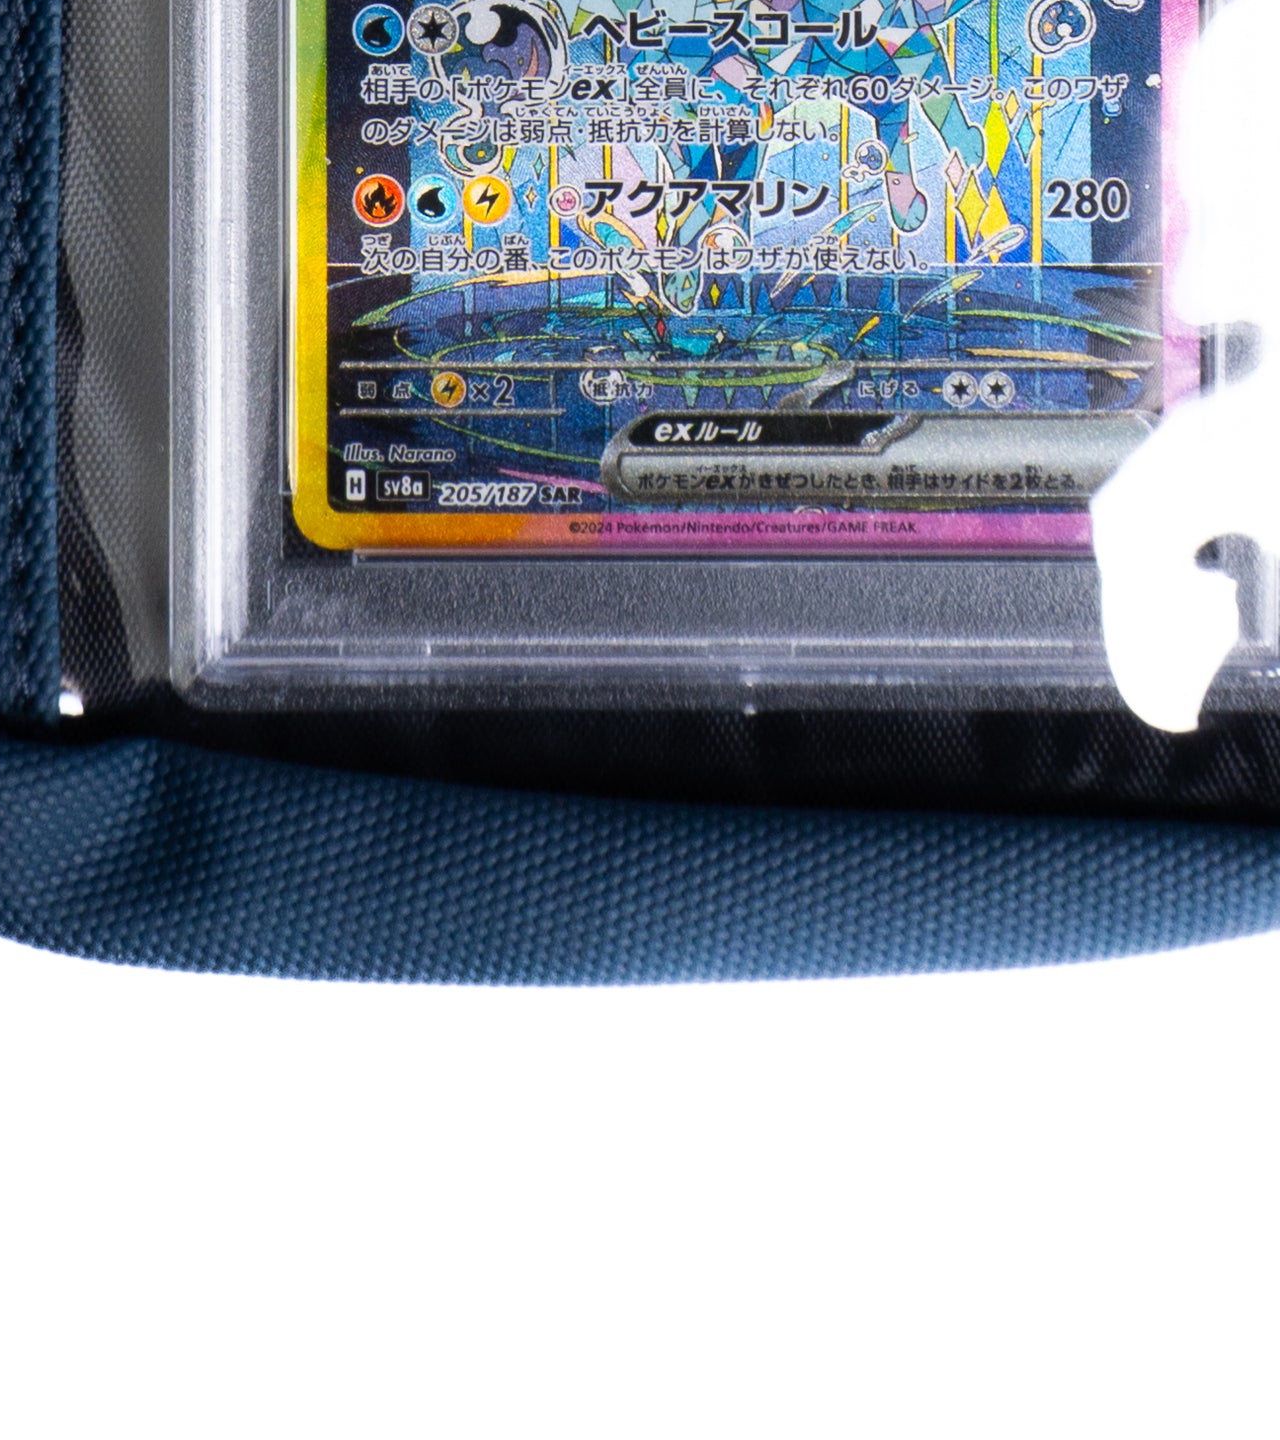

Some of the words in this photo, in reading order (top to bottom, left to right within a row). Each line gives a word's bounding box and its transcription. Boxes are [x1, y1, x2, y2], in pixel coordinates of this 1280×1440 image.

[582, 9, 879, 50] ヘビースコール
[582, 180, 831, 218] アクアマリン
[1046, 179, 1128, 220] 280
[388, 444, 457, 463] Narano
[349, 475, 363, 494] H
[439, 483, 537, 506] 205/187
[540, 486, 582, 504] SAR
